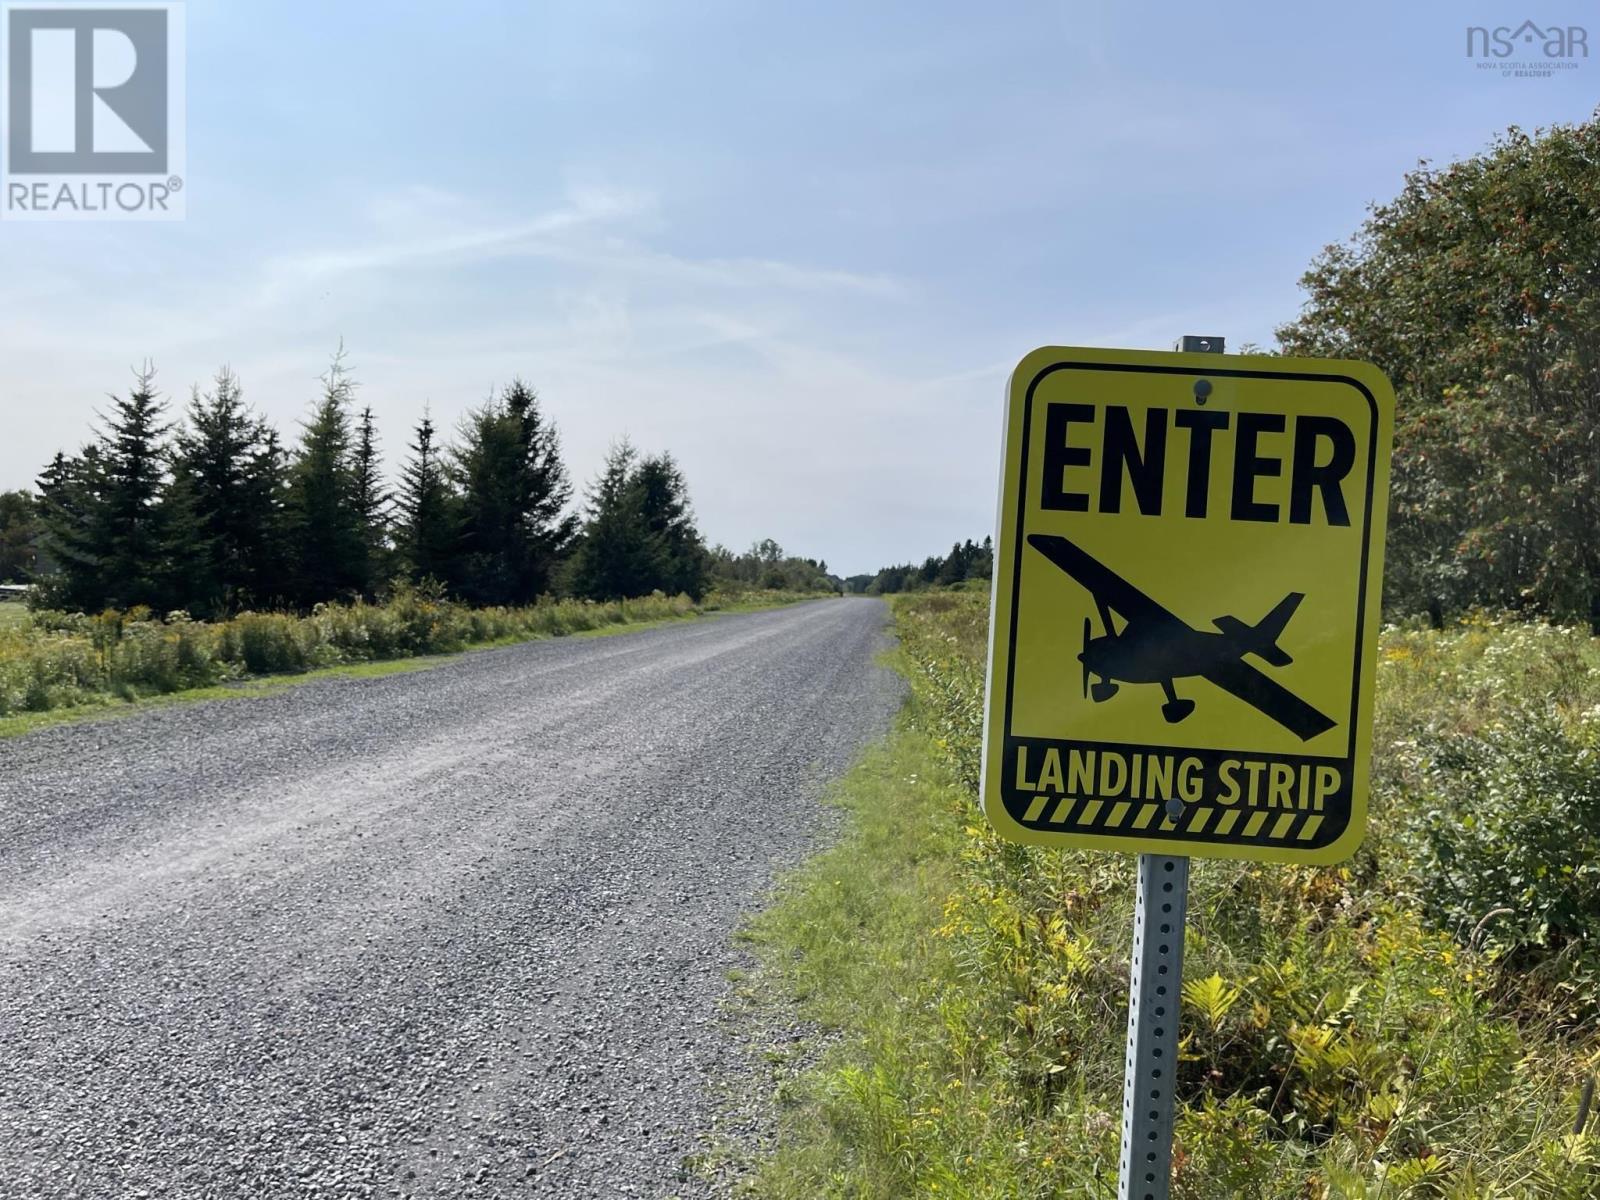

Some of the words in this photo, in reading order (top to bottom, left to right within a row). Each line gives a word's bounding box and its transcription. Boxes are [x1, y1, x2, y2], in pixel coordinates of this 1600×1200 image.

[1041, 402, 1357, 527] ENTER
[1015, 745, 1204, 803] LANDING
[1217, 759, 1342, 811] STRIP
